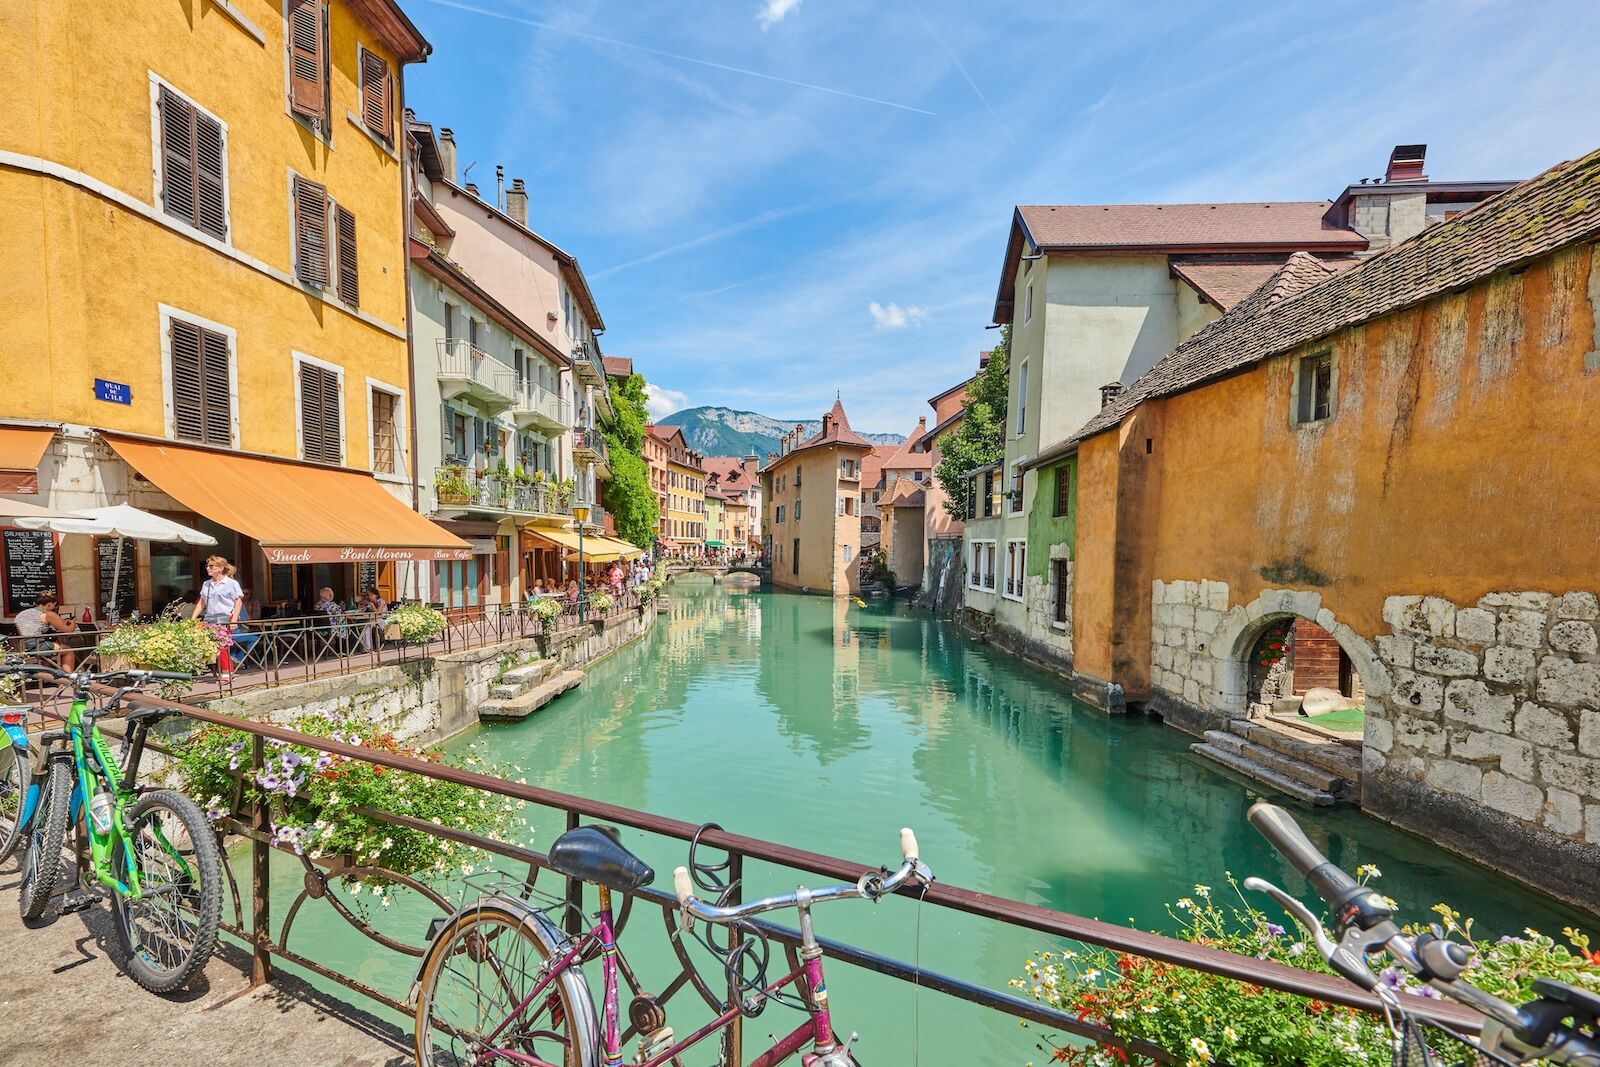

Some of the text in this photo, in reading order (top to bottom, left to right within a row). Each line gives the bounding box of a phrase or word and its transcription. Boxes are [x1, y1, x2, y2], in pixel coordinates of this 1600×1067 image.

[104, 382, 121, 390] QUAI
[271, 548, 312, 562] Snack
[340, 547, 371, 560] Pont
[370, 547, 413, 560] Morens
[433, 549, 450, 559] Bar
